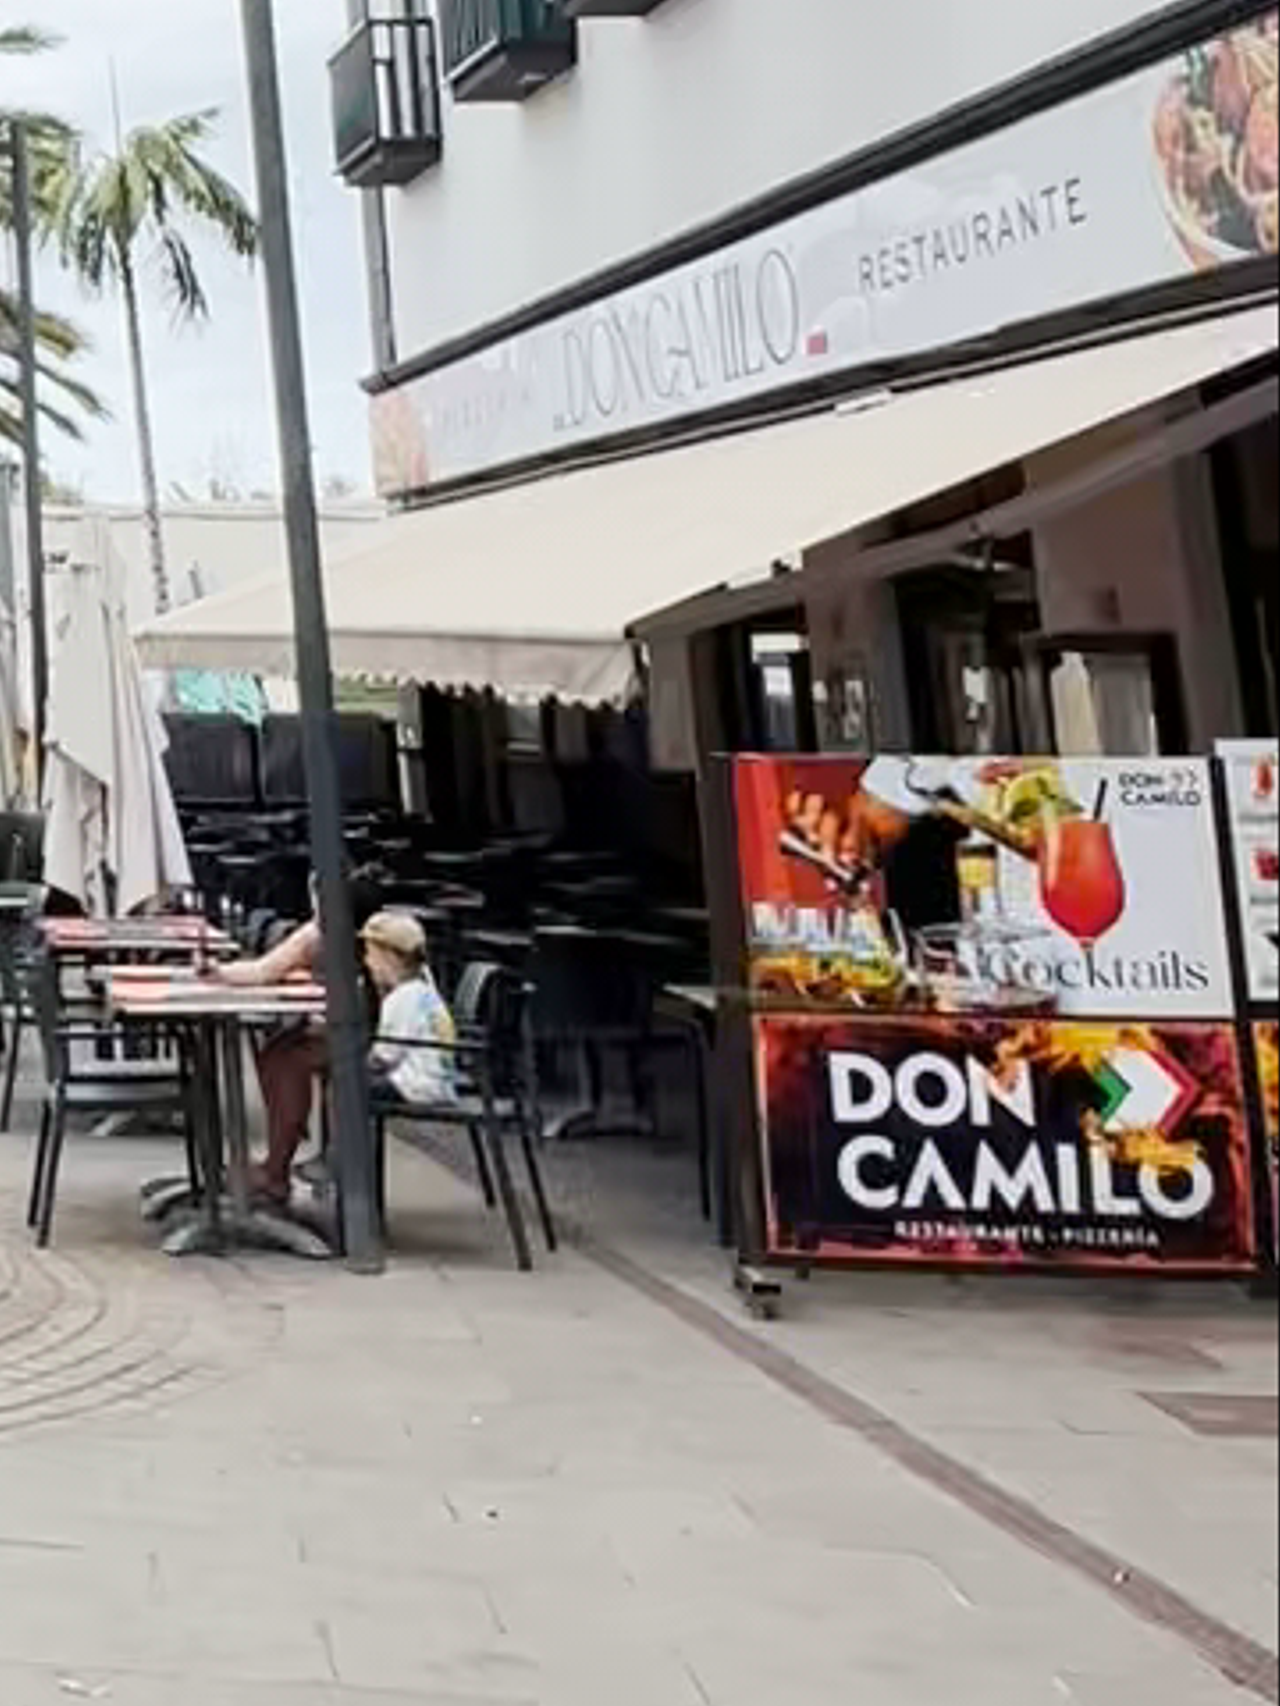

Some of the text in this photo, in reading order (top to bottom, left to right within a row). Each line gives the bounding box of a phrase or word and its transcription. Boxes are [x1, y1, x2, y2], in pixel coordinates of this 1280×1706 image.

[858, 177, 1088, 292] RESTAURANTE
[1119, 772, 1164, 789] DON
[1121, 789, 1202, 808] CAMILO
[828, 1051, 1037, 1127] DON
[838, 1132, 1215, 1220] CAMILO
[894, 1220, 1045, 1245] RESTAURANTE
